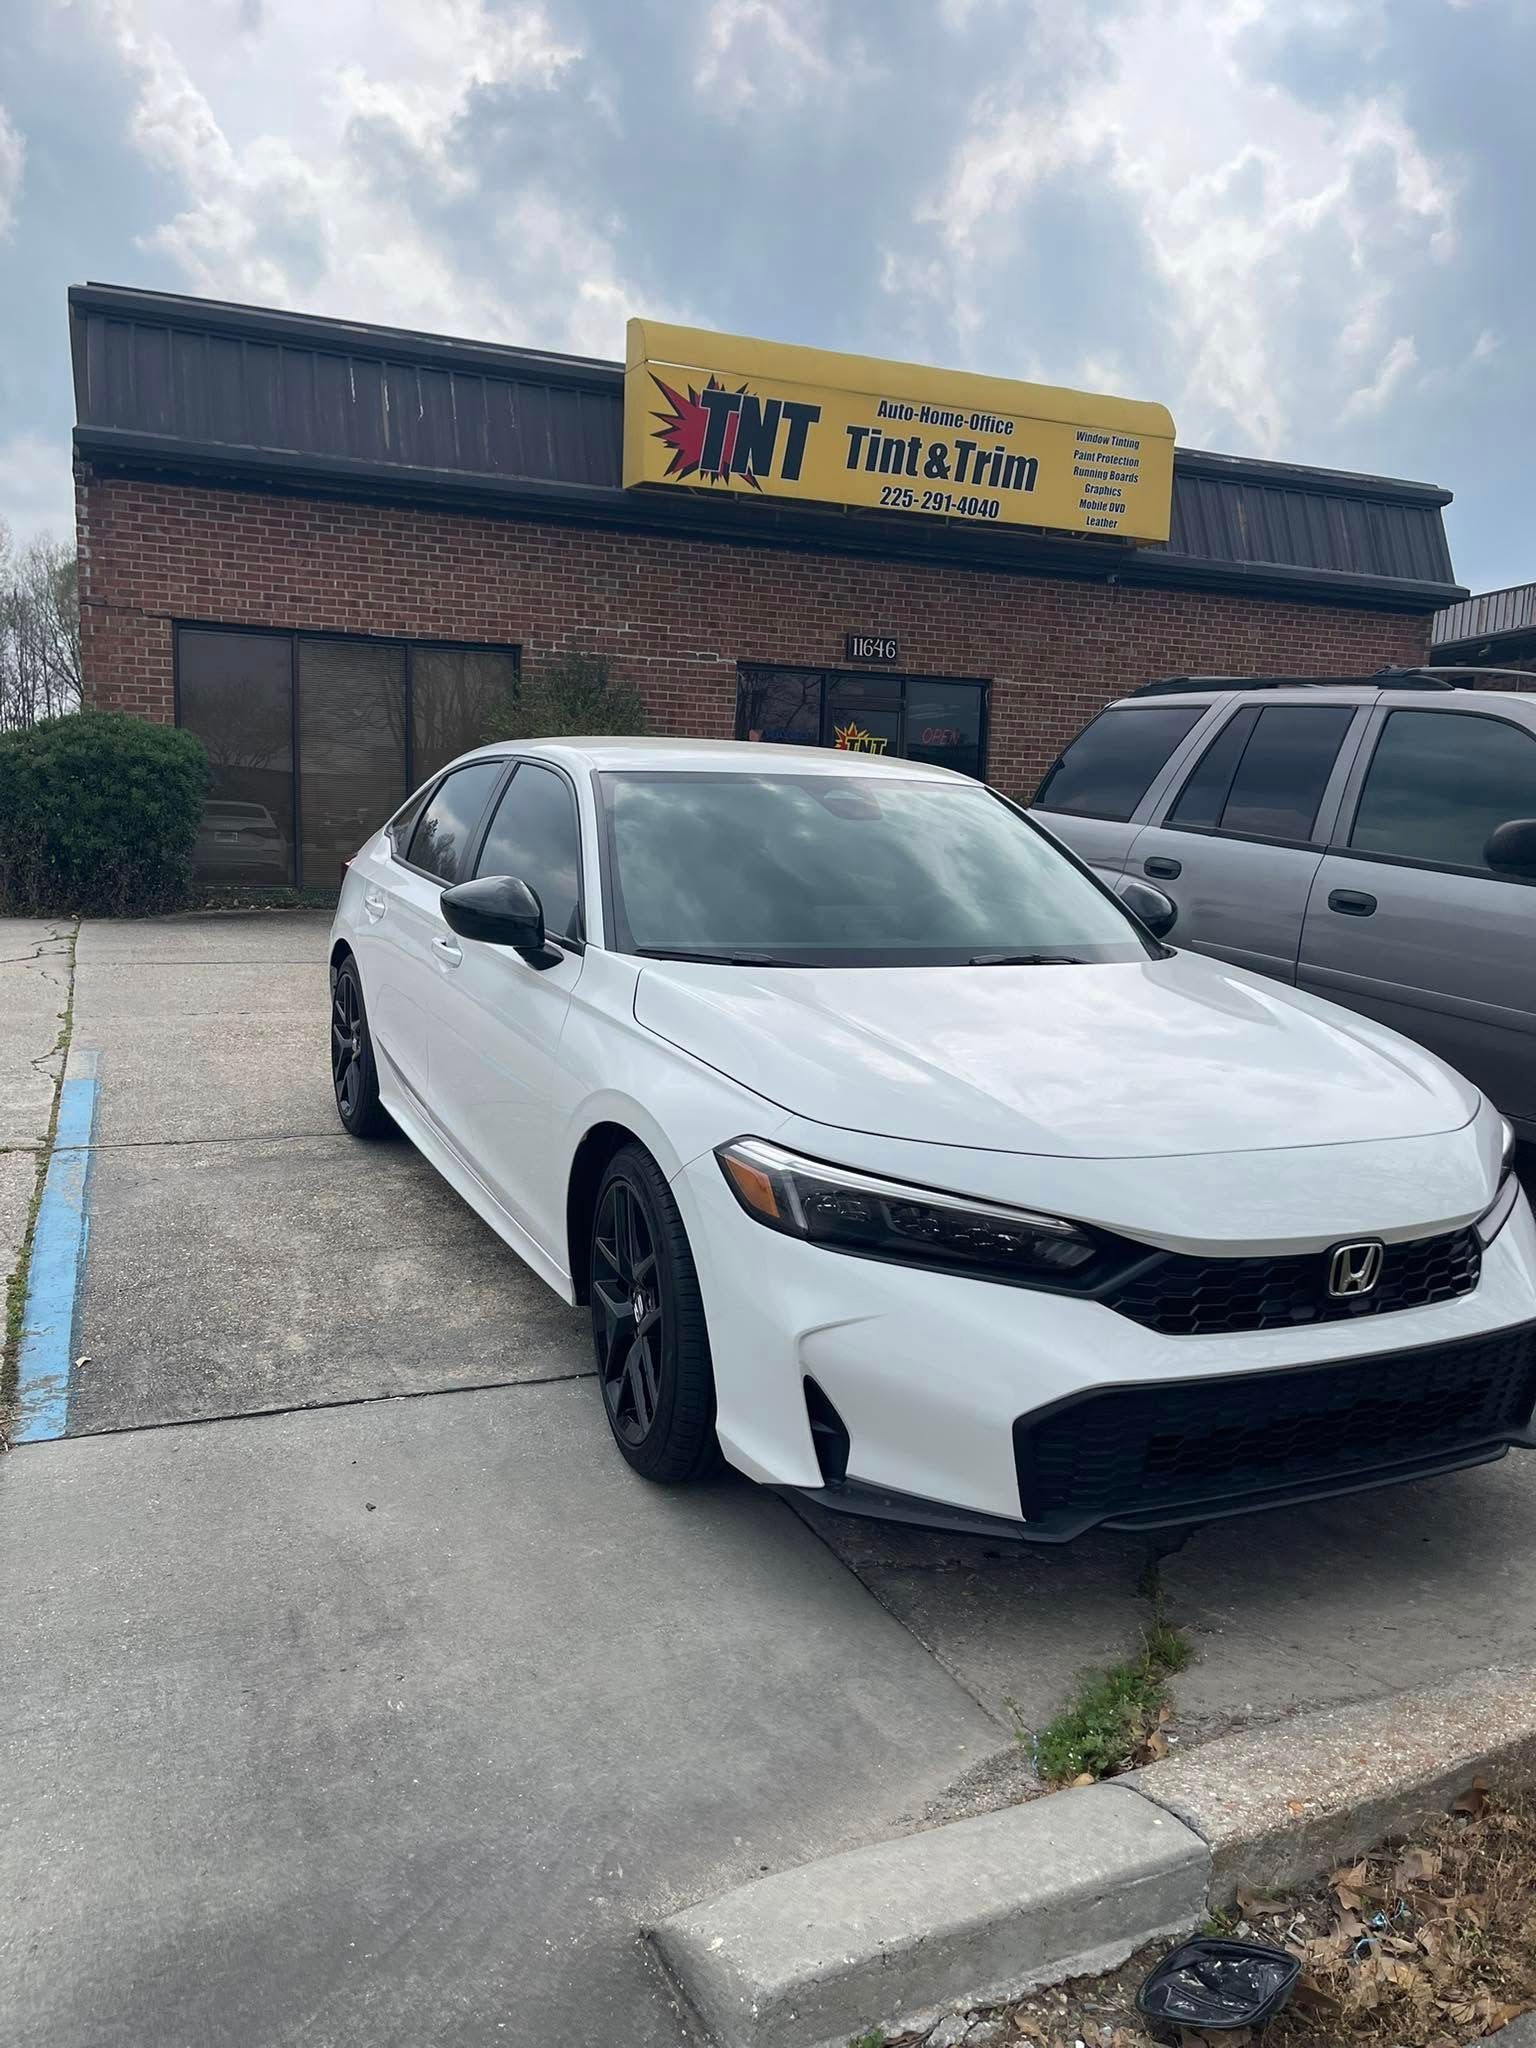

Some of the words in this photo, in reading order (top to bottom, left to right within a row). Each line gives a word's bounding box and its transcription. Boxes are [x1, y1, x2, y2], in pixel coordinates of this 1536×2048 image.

[877, 400, 1014, 435] Auto-Home-Office
[700, 389, 822, 481] TNT
[1076, 430, 1110, 445] Window
[1111, 436, 1140, 450] Tinting
[1073, 449, 1096, 462] Paint
[1096, 452, 1140, 467] Protection
[1073, 465, 1108, 480] Running
[1109, 470, 1139, 483] Boards
[1084, 483, 1122, 497] Graphics
[1079, 498, 1107, 511] Mobile
[1108, 502, 1126, 513] DVD
[1086, 515, 1118, 528] Leather
[853, 637, 896, 659] 11646
[921, 727, 961, 745] OPEN
[846, 738, 887, 756] TNT
